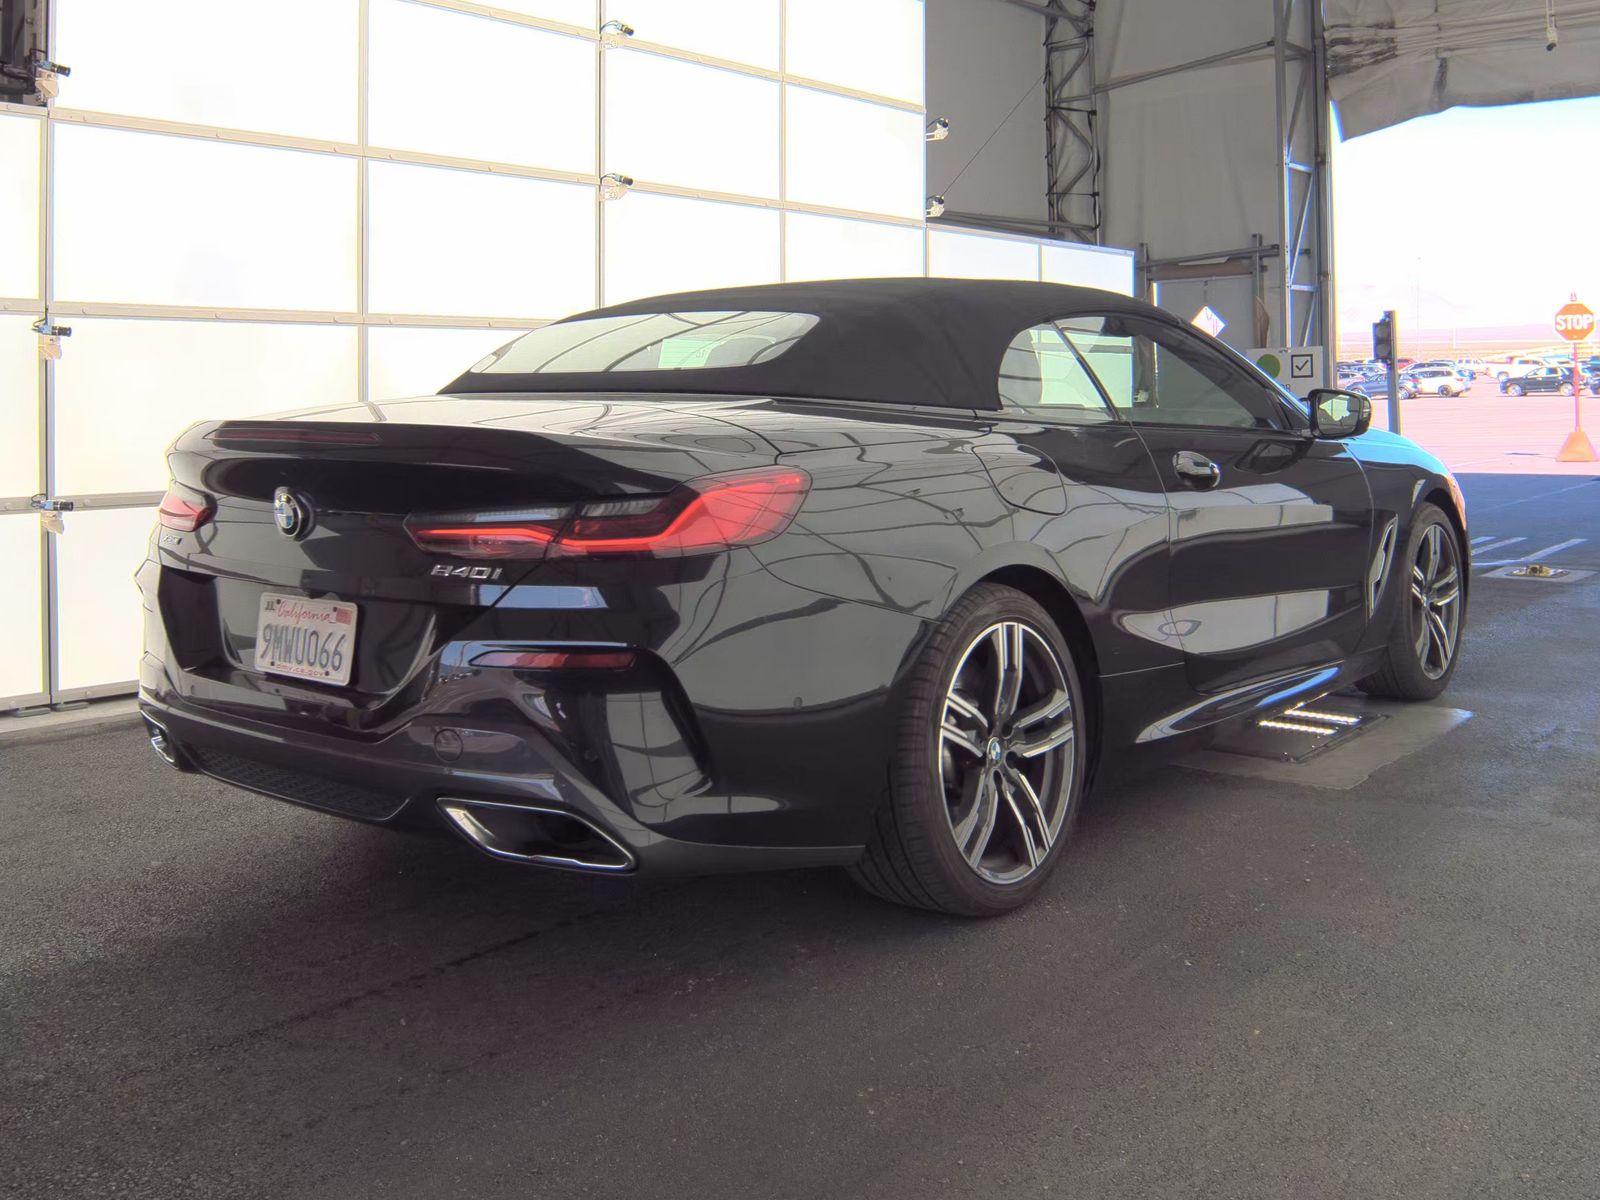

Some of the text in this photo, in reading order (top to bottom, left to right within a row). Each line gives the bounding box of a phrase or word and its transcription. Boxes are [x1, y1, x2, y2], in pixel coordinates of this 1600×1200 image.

[1556, 314, 1594, 330] STOP
[277, 600, 336, 625] California
[260, 624, 346, 671] 9MWU066
